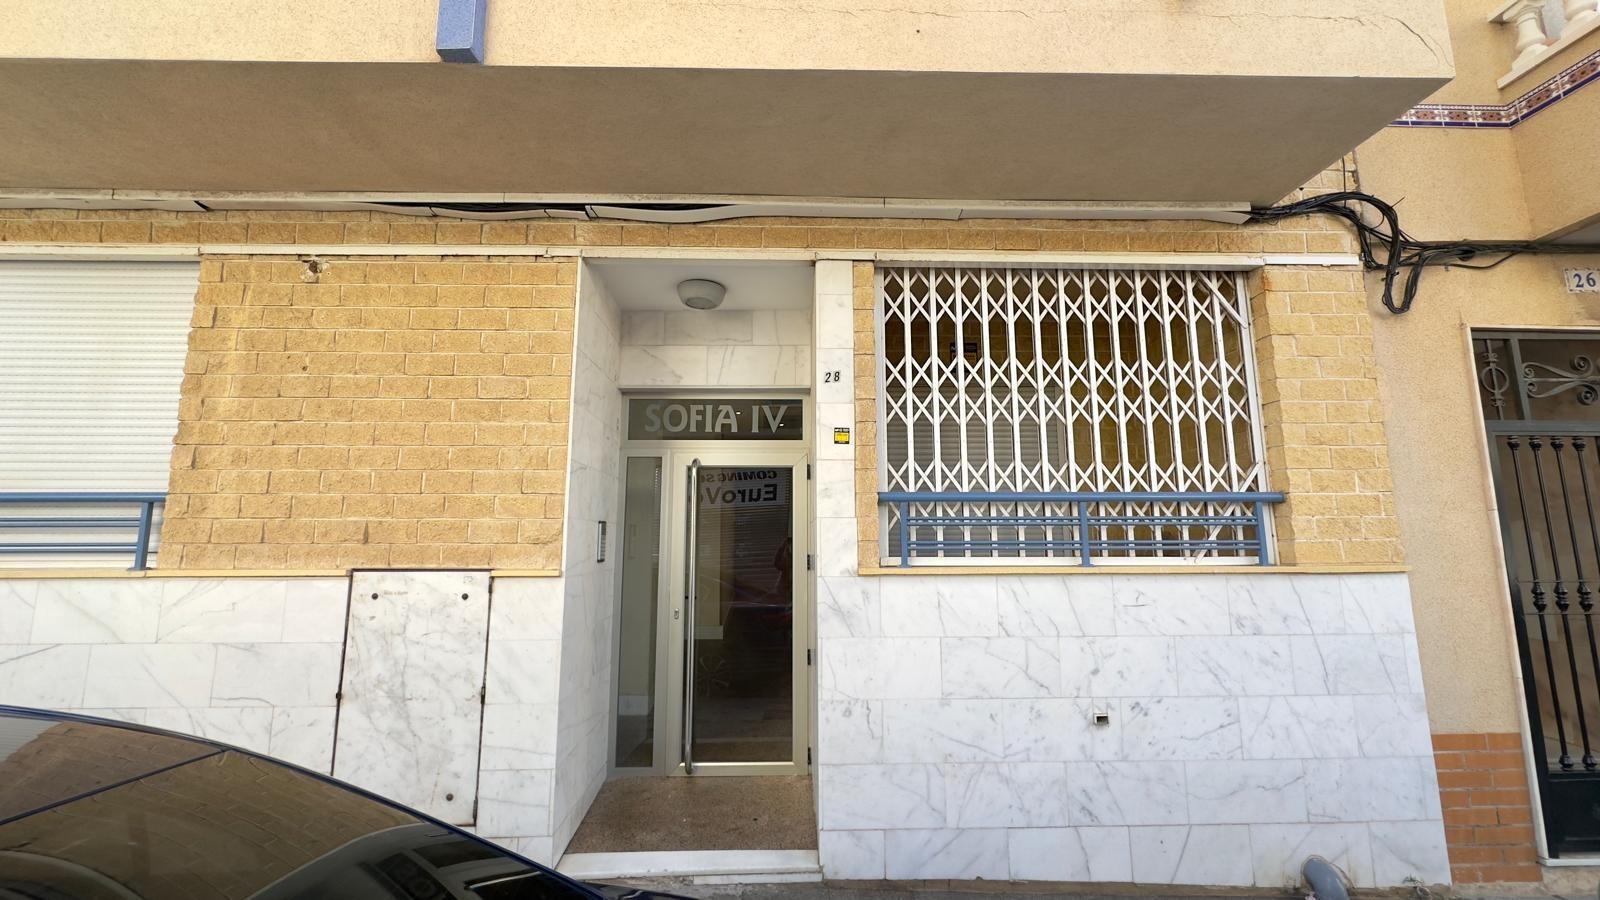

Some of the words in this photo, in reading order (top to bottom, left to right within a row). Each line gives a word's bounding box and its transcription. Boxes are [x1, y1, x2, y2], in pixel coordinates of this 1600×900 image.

[1573, 271, 1596, 288] 26
[824, 371, 841, 383] 28
[645, 404, 738, 433] SOFIA
[751, 405, 788, 433] IV
